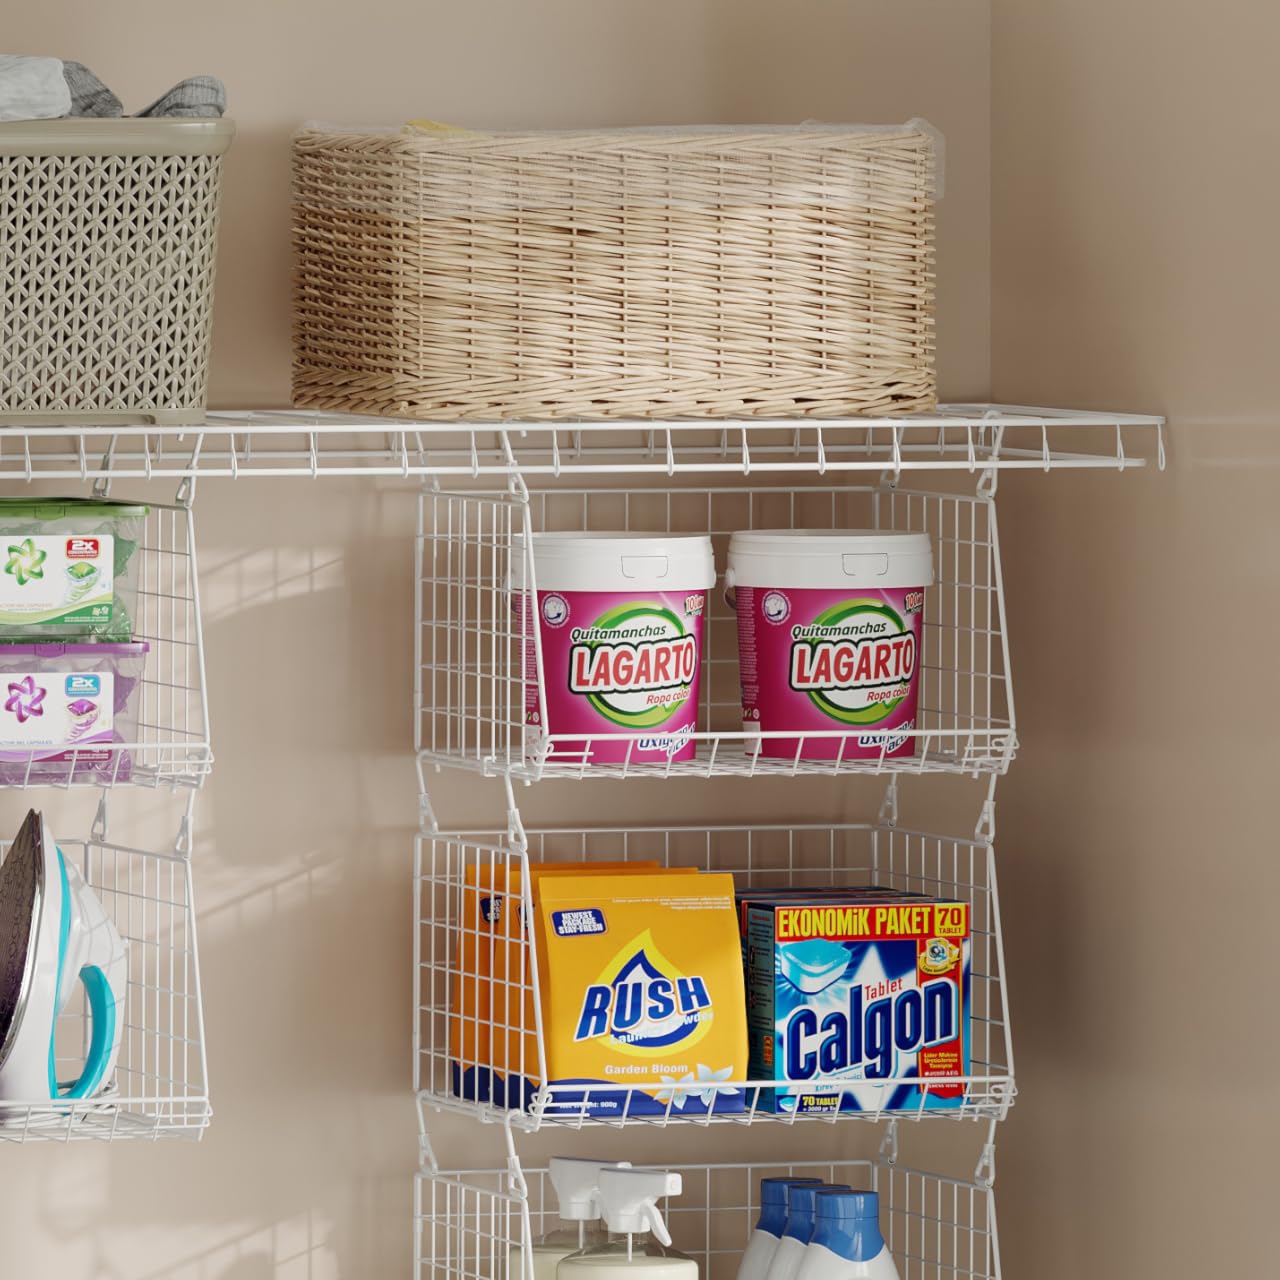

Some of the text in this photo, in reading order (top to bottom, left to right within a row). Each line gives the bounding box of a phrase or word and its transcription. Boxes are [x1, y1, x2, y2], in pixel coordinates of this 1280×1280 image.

[571, 624, 666, 642] Quitamanchas
[792, 622, 887, 640] Quitamanchas
[576, 641, 693, 687] LAGARTO
[797, 639, 913, 684] LAGARTO
[646, 693, 671, 705] Ropa
[867, 690, 891, 701] Ropa
[875, 907, 931, 935] PAKET
[938, 907, 961, 927] 70
[865, 978, 903, 1001] Tablet
[574, 977, 711, 1041] RUSH
[787, 982, 953, 1080] Calgon
[605, 1064, 688, 1074] Garden Bloom
[803, 1096, 815, 1106] 70
